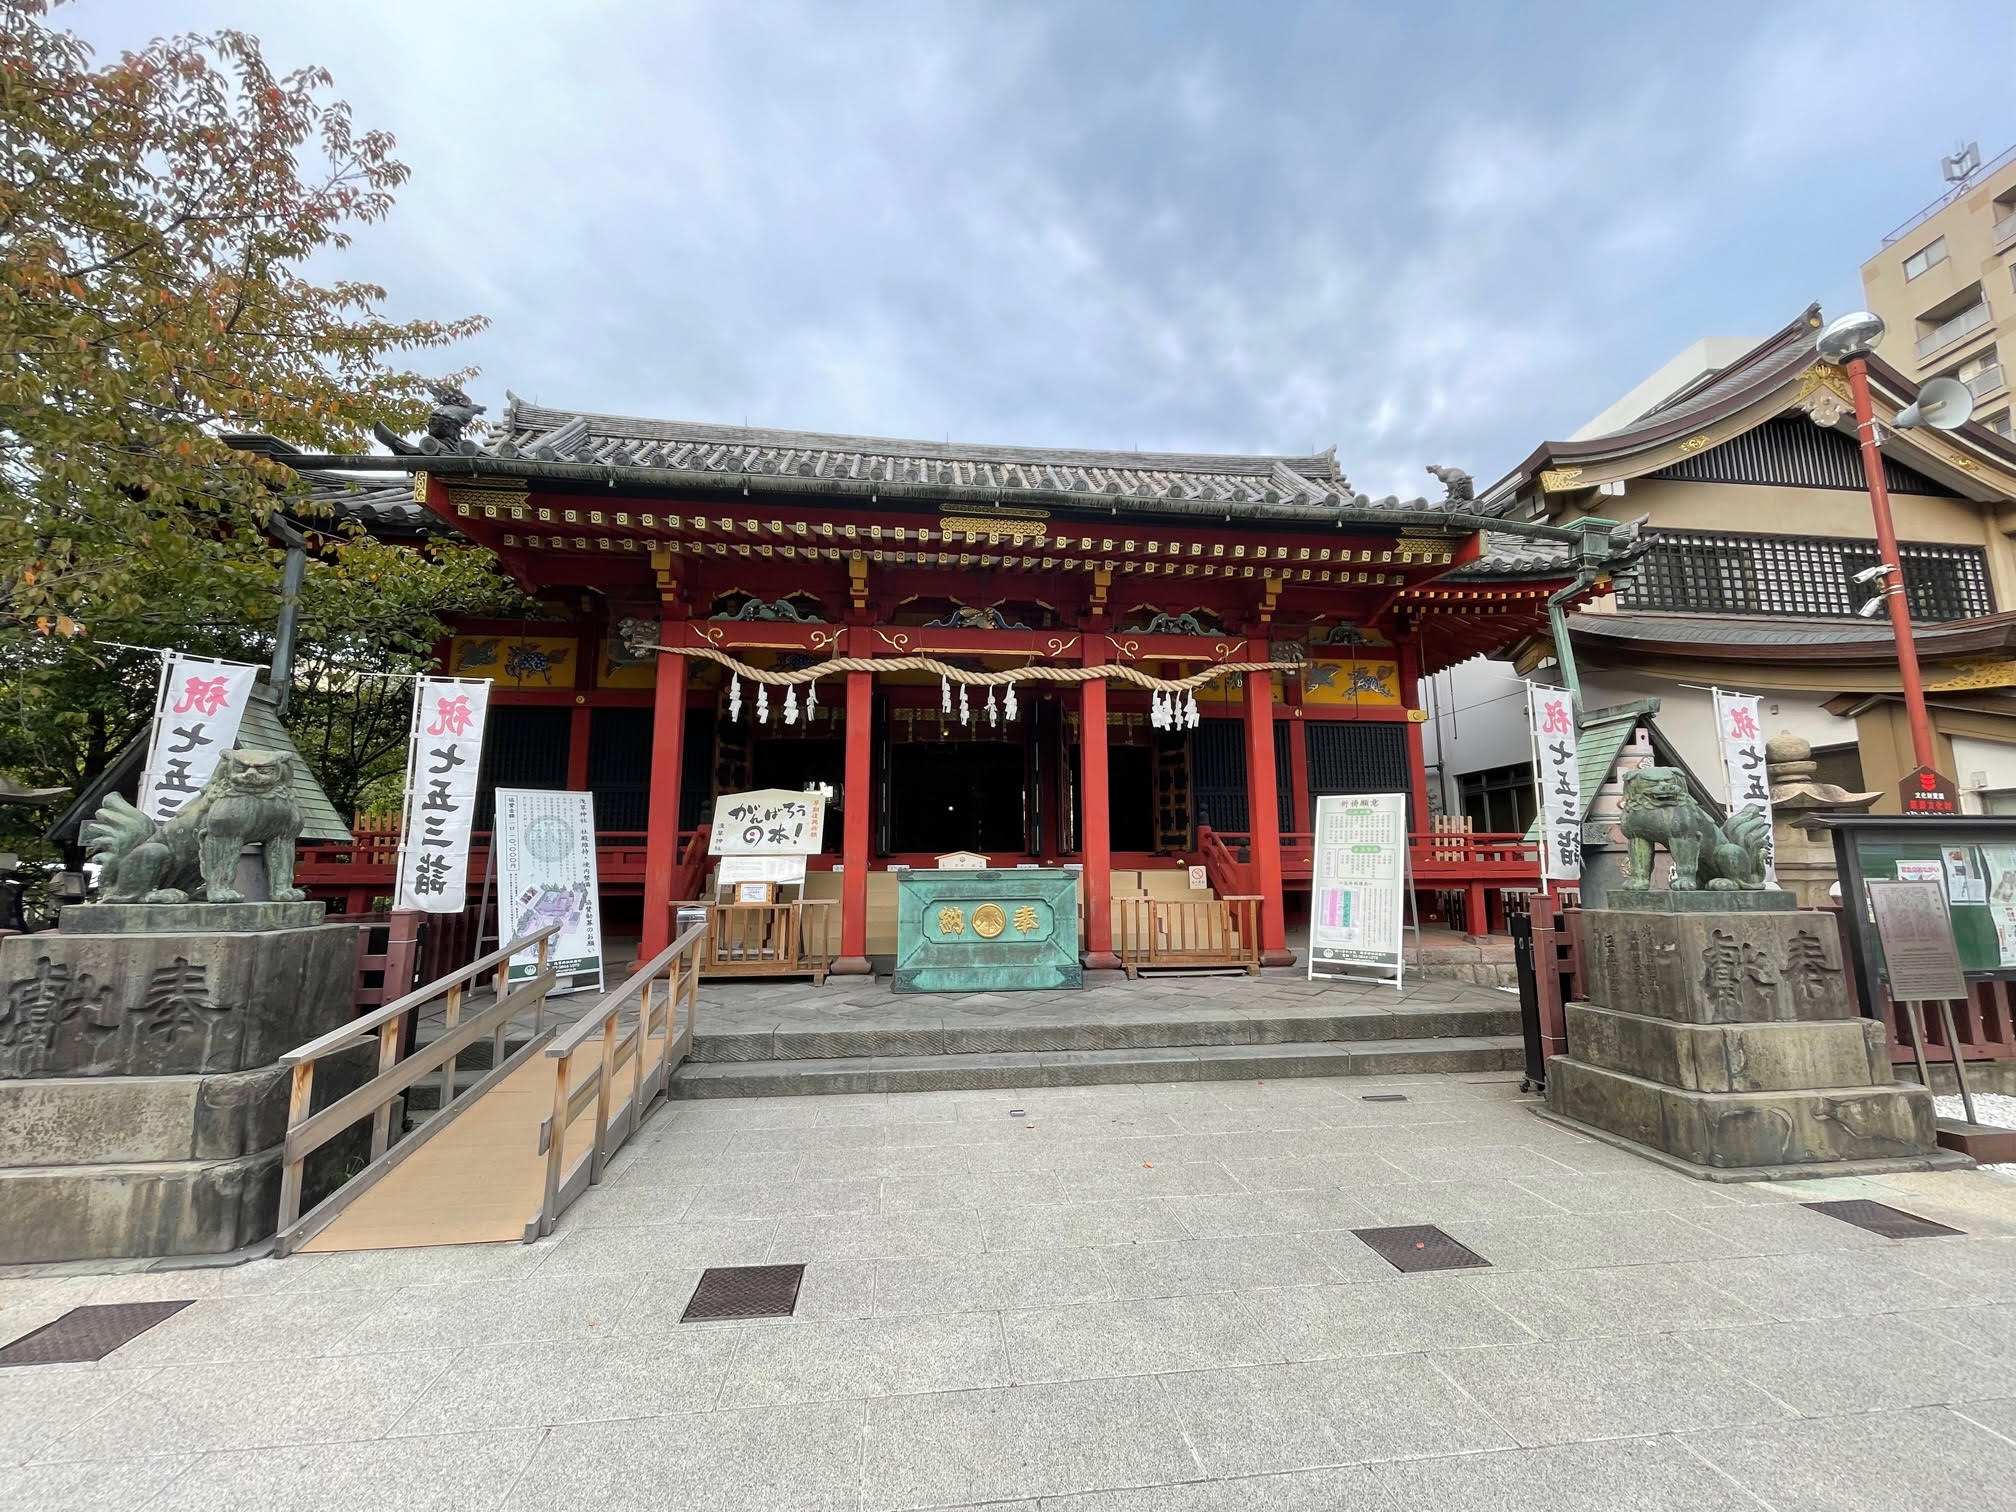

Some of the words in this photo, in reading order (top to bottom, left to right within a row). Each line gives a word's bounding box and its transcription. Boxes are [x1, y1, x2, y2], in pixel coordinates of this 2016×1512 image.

[728, 803, 806, 824] がんばろう
[714, 823, 725, 851] 浅草神社
